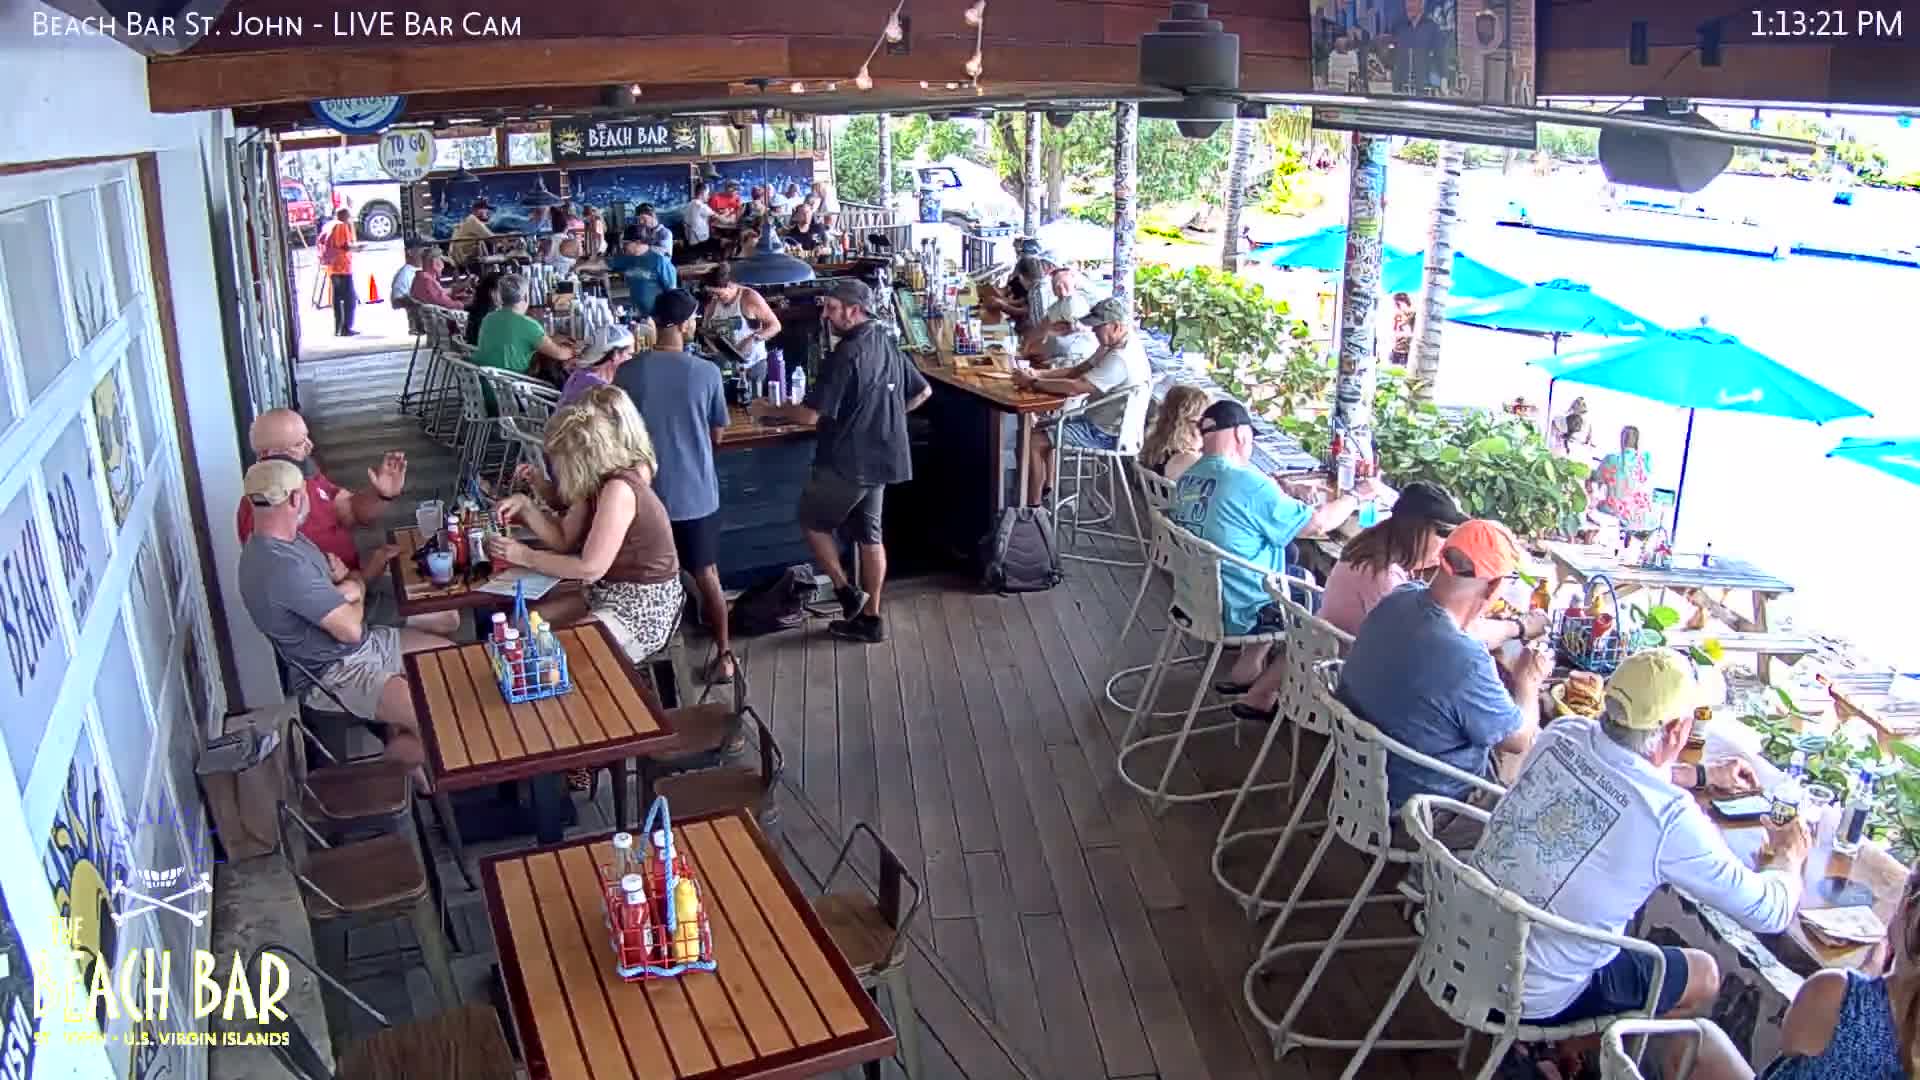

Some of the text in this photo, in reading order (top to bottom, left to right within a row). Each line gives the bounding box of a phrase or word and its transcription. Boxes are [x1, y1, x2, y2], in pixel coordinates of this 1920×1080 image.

[386, 132, 426, 155] TO GO
[588, 125, 668, 147] BEACH BAR
